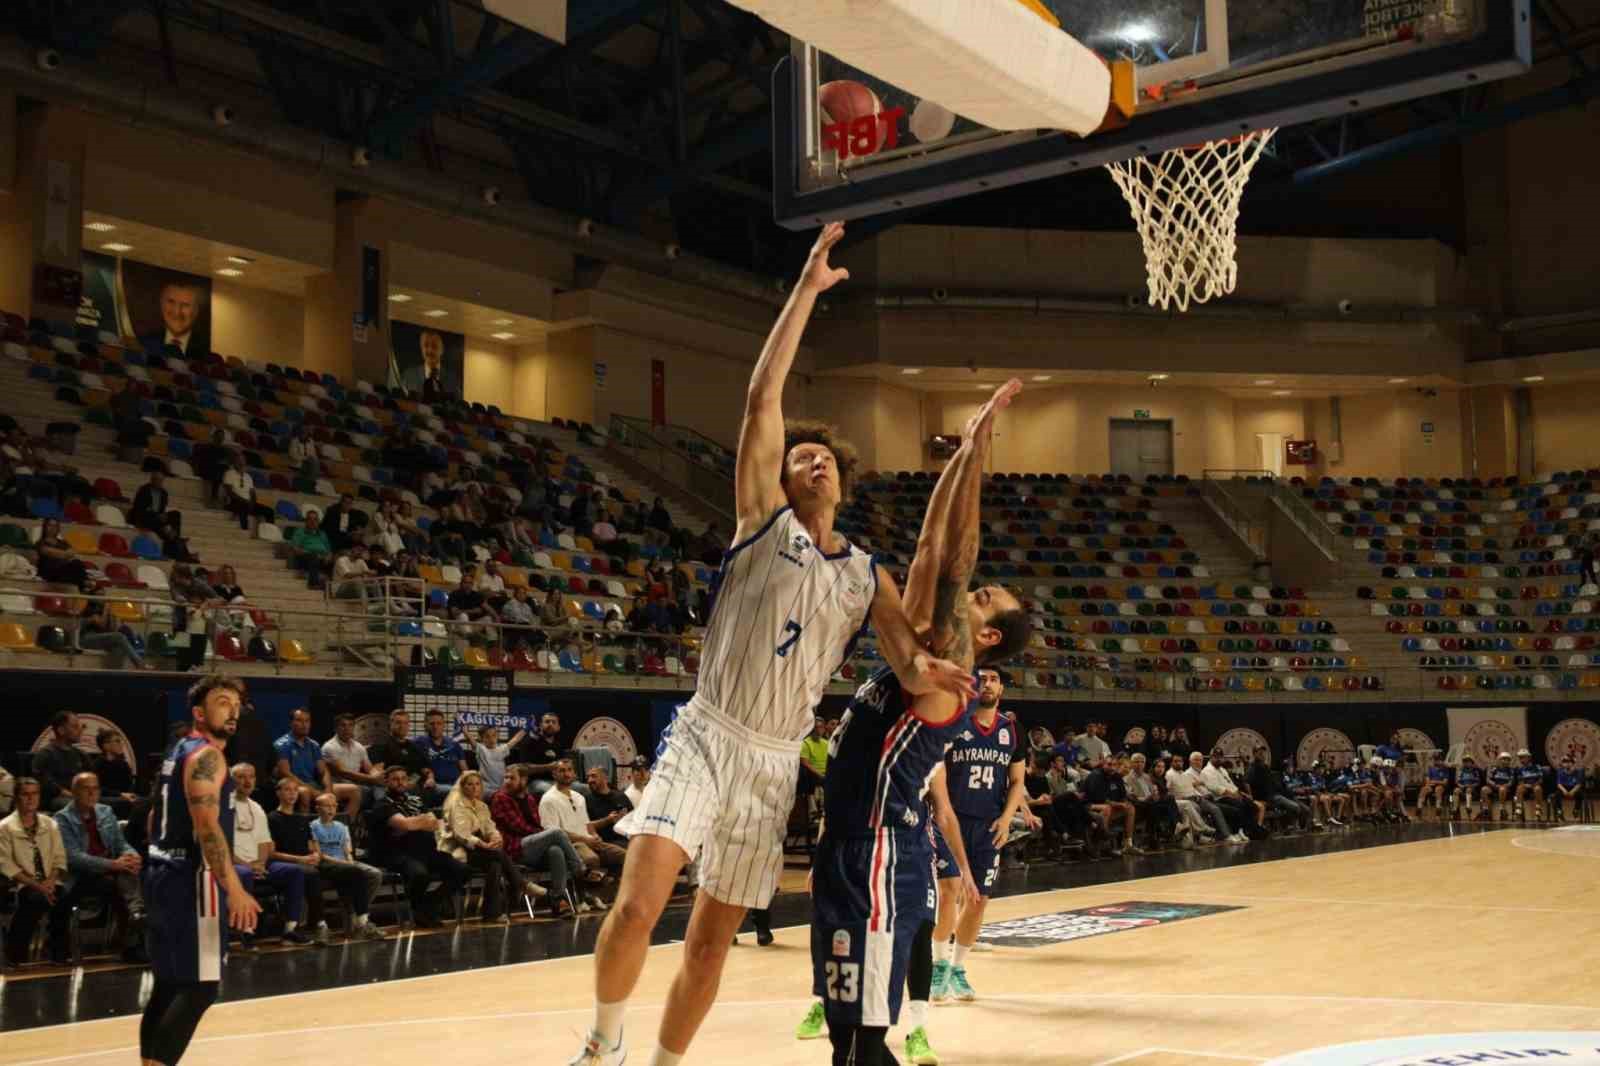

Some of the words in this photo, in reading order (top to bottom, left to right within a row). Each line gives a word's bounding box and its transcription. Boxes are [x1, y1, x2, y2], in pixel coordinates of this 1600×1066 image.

[776, 619, 803, 657] 7
[968, 765, 994, 790] 24
[825, 961, 859, 1003] 23
